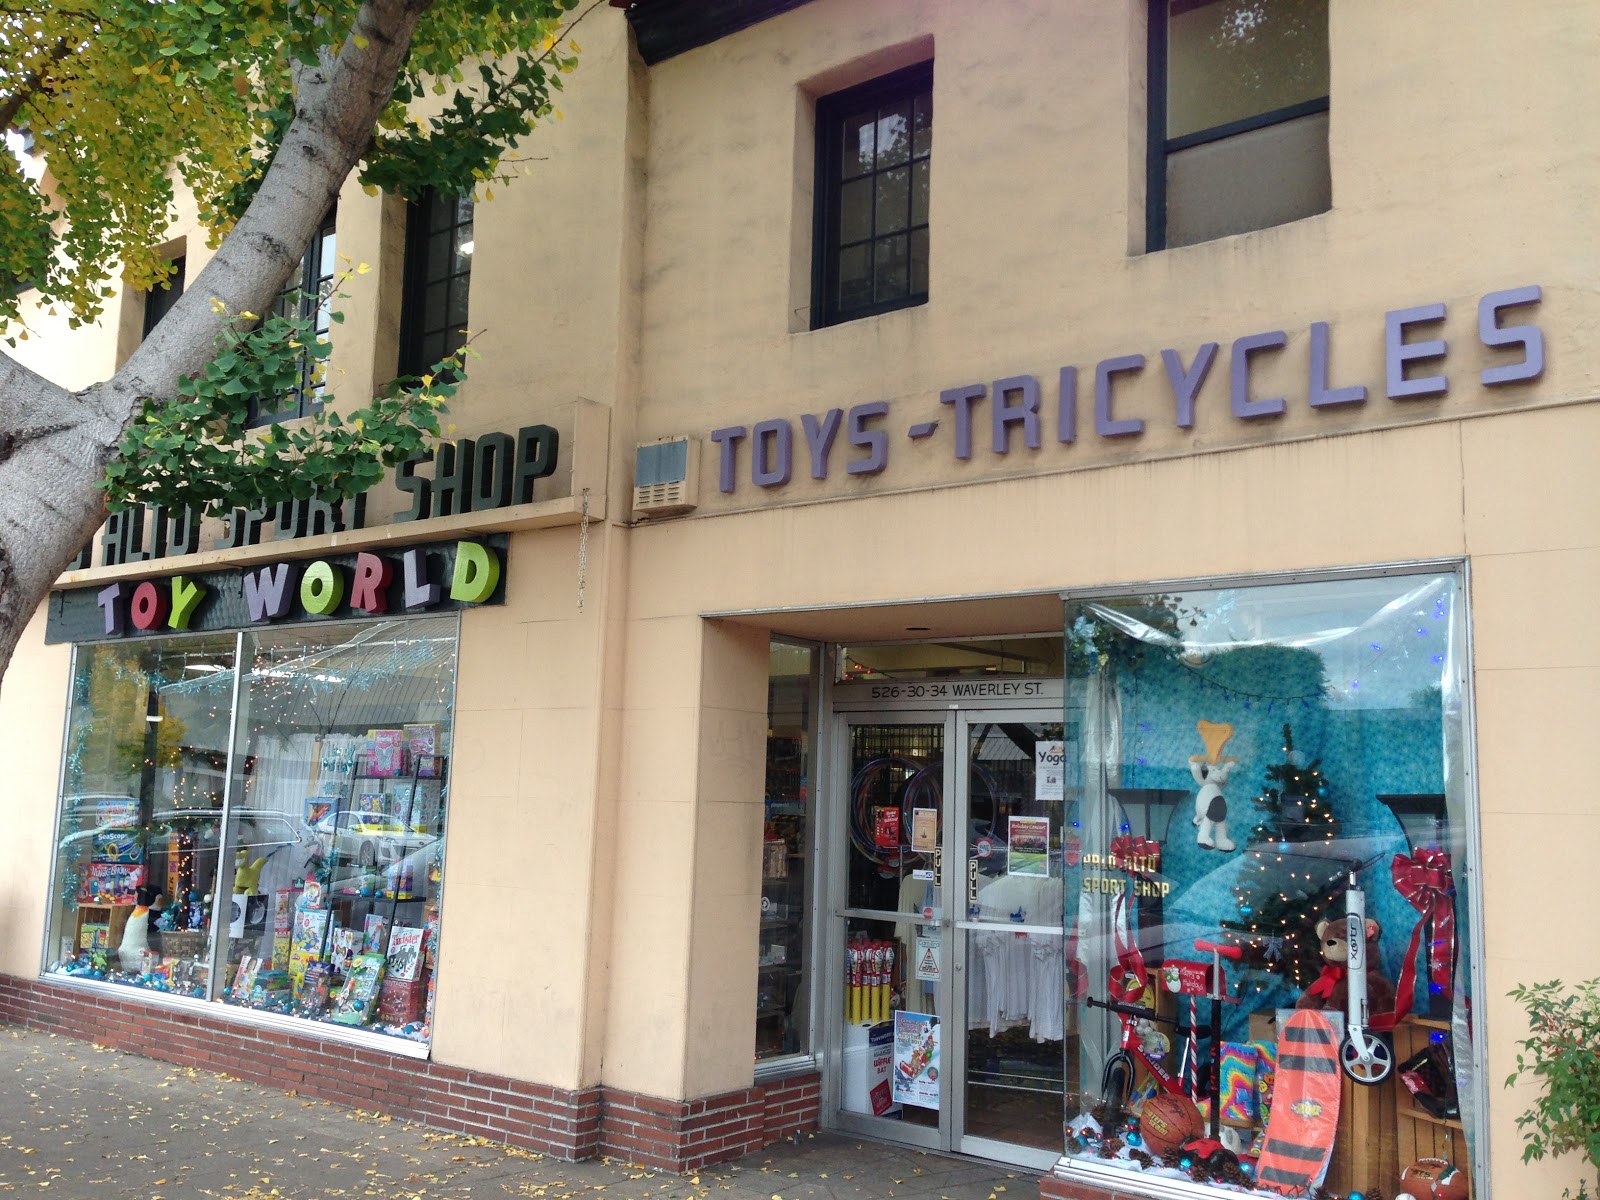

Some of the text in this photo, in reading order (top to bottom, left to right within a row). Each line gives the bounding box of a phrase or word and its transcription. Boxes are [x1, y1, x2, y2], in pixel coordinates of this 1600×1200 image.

[394, 424, 559, 523] SHOP
[98, 541, 499, 636] TOY WORLD
[871, 682, 1044, 699] 526-30-34 WAVERLEY ST.
[1083, 877, 1171, 899] SPORT SHOP
[391, 933, 421, 946] Twister
